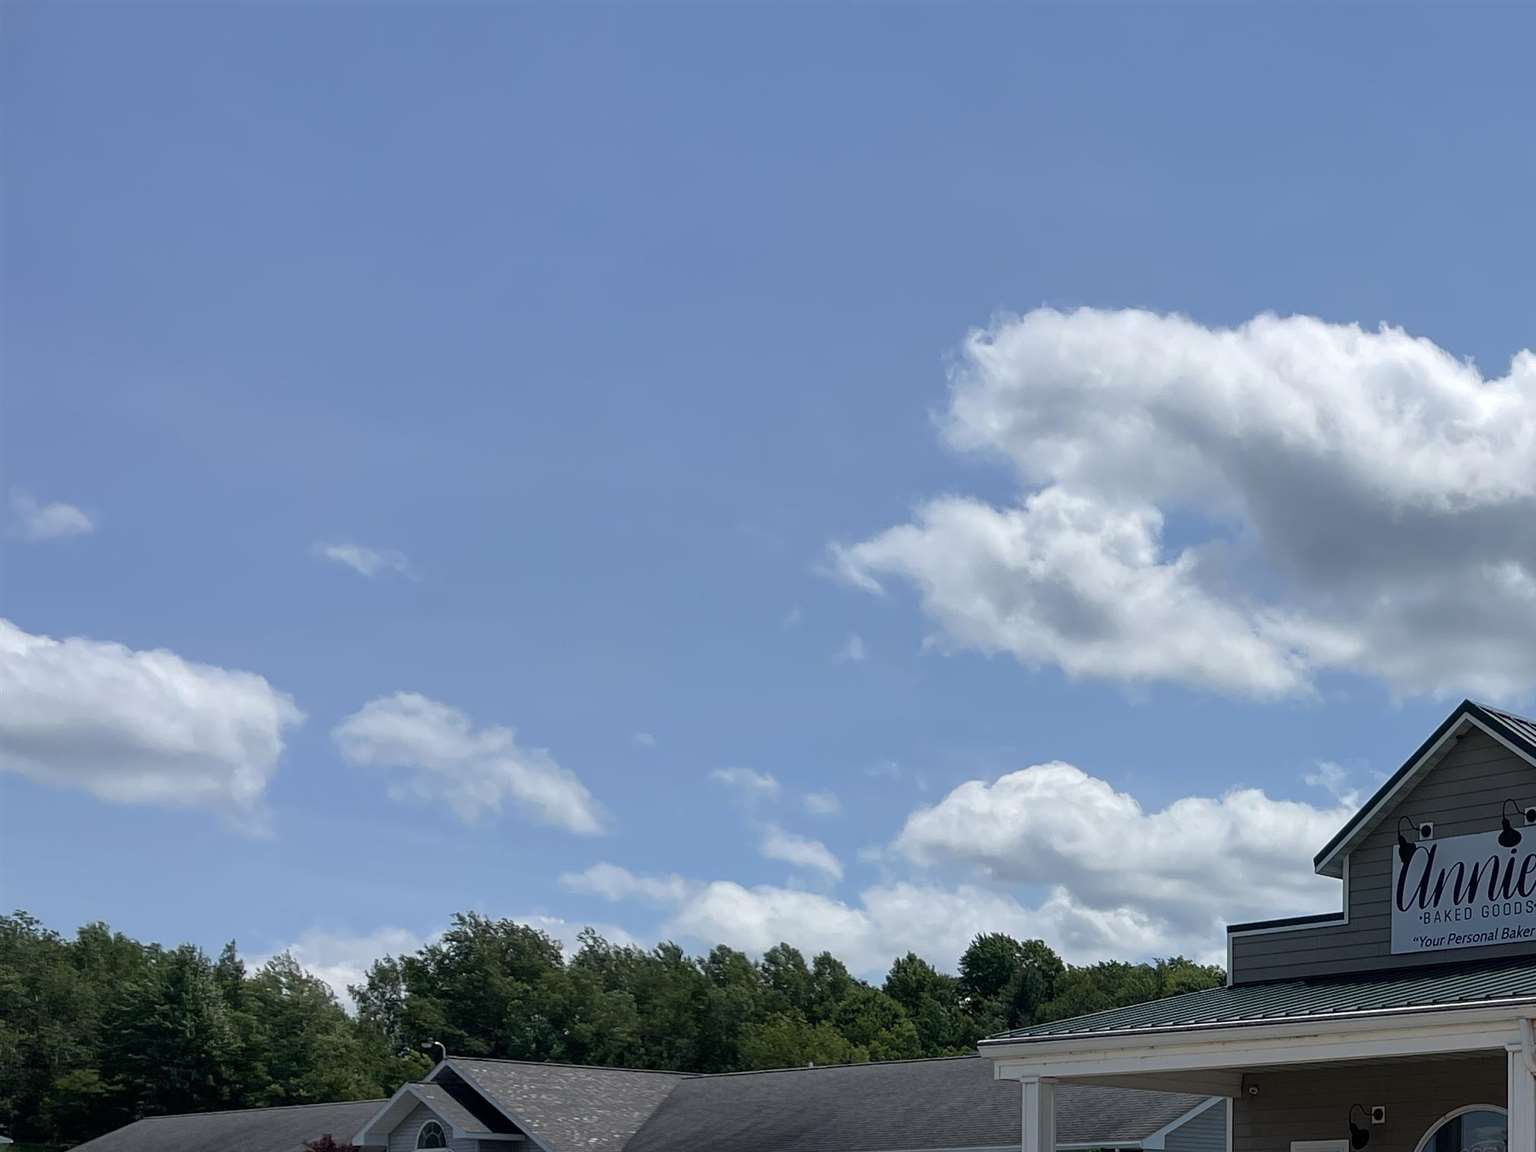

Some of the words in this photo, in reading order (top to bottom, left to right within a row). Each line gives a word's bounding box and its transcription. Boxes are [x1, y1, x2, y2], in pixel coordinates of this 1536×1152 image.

[1424, 907, 1473, 925] BAKED
[1482, 900, 1534, 919] GOODS
[1447, 928, 1498, 945] Personal
